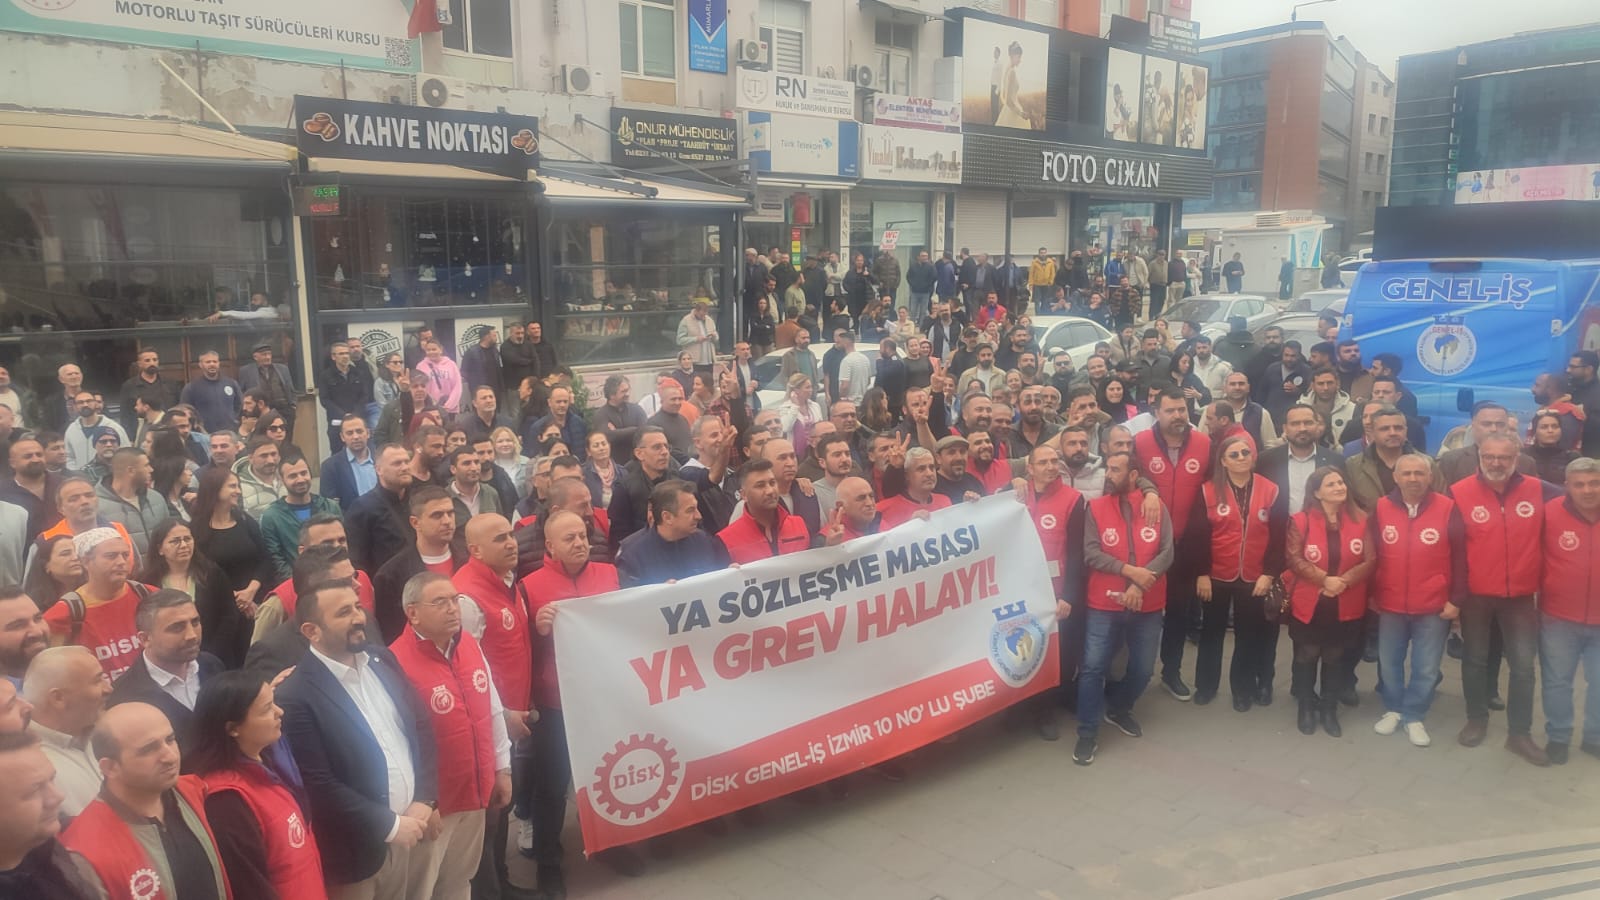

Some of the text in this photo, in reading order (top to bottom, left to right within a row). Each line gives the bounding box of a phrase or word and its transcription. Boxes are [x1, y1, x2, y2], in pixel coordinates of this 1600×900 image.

[115, 0, 381, 46] MOTORLU TAŞIT SÜRÜCÜLERİ KURSU
[775, 75, 807, 99] RN
[343, 113, 509, 154] KAHVE NOKTASI
[635, 121, 667, 136] ONUR
[1041, 151, 1097, 184] FOTO
[1380, 272, 1533, 310] GENEL-İŞ
[660, 524, 980, 635] YA SÖZLEŞME MASASI
[629, 555, 1000, 706] YA GREV HALAYI!
[690, 772, 740, 801] DİSK
[744, 741, 826, 785] GENEL-İŞ
[826, 723, 873, 757] İZMİR
[874, 717, 893, 737] 10
[928, 695, 951, 718] LU
[952, 679, 996, 710] ŞUBE
[613, 763, 661, 790] DİSK
